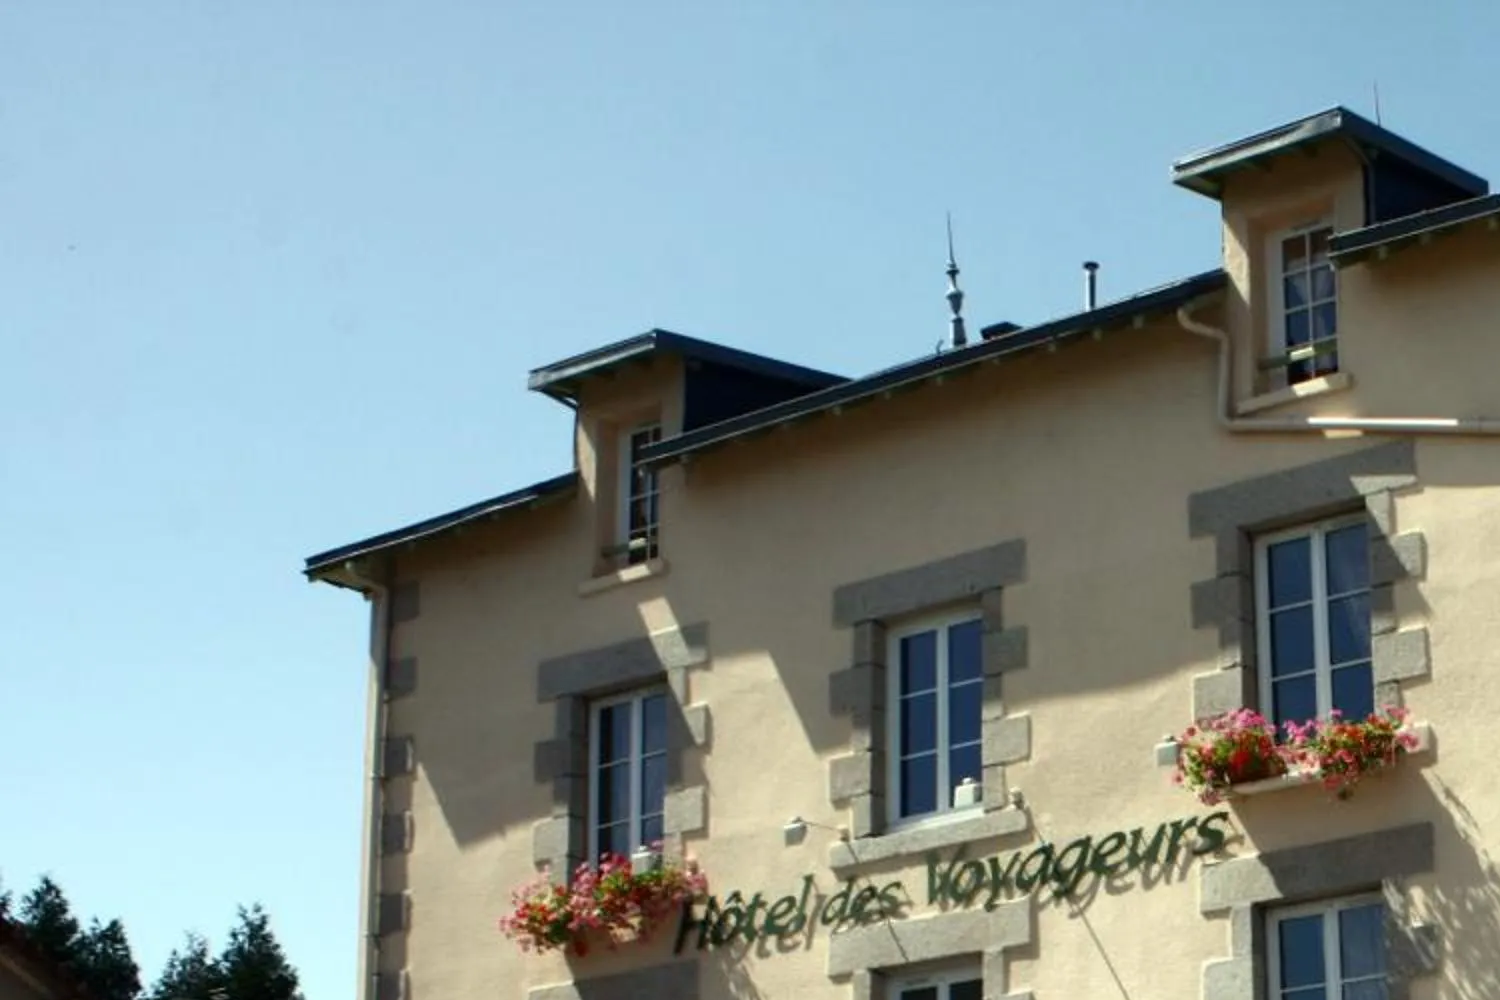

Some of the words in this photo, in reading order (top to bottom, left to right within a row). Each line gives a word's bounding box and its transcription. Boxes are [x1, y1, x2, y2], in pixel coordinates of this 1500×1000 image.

[674, 874, 814, 955] Hôtel
[821, 875, 903, 925] des
[926, 812, 1228, 912] Voyageurs
